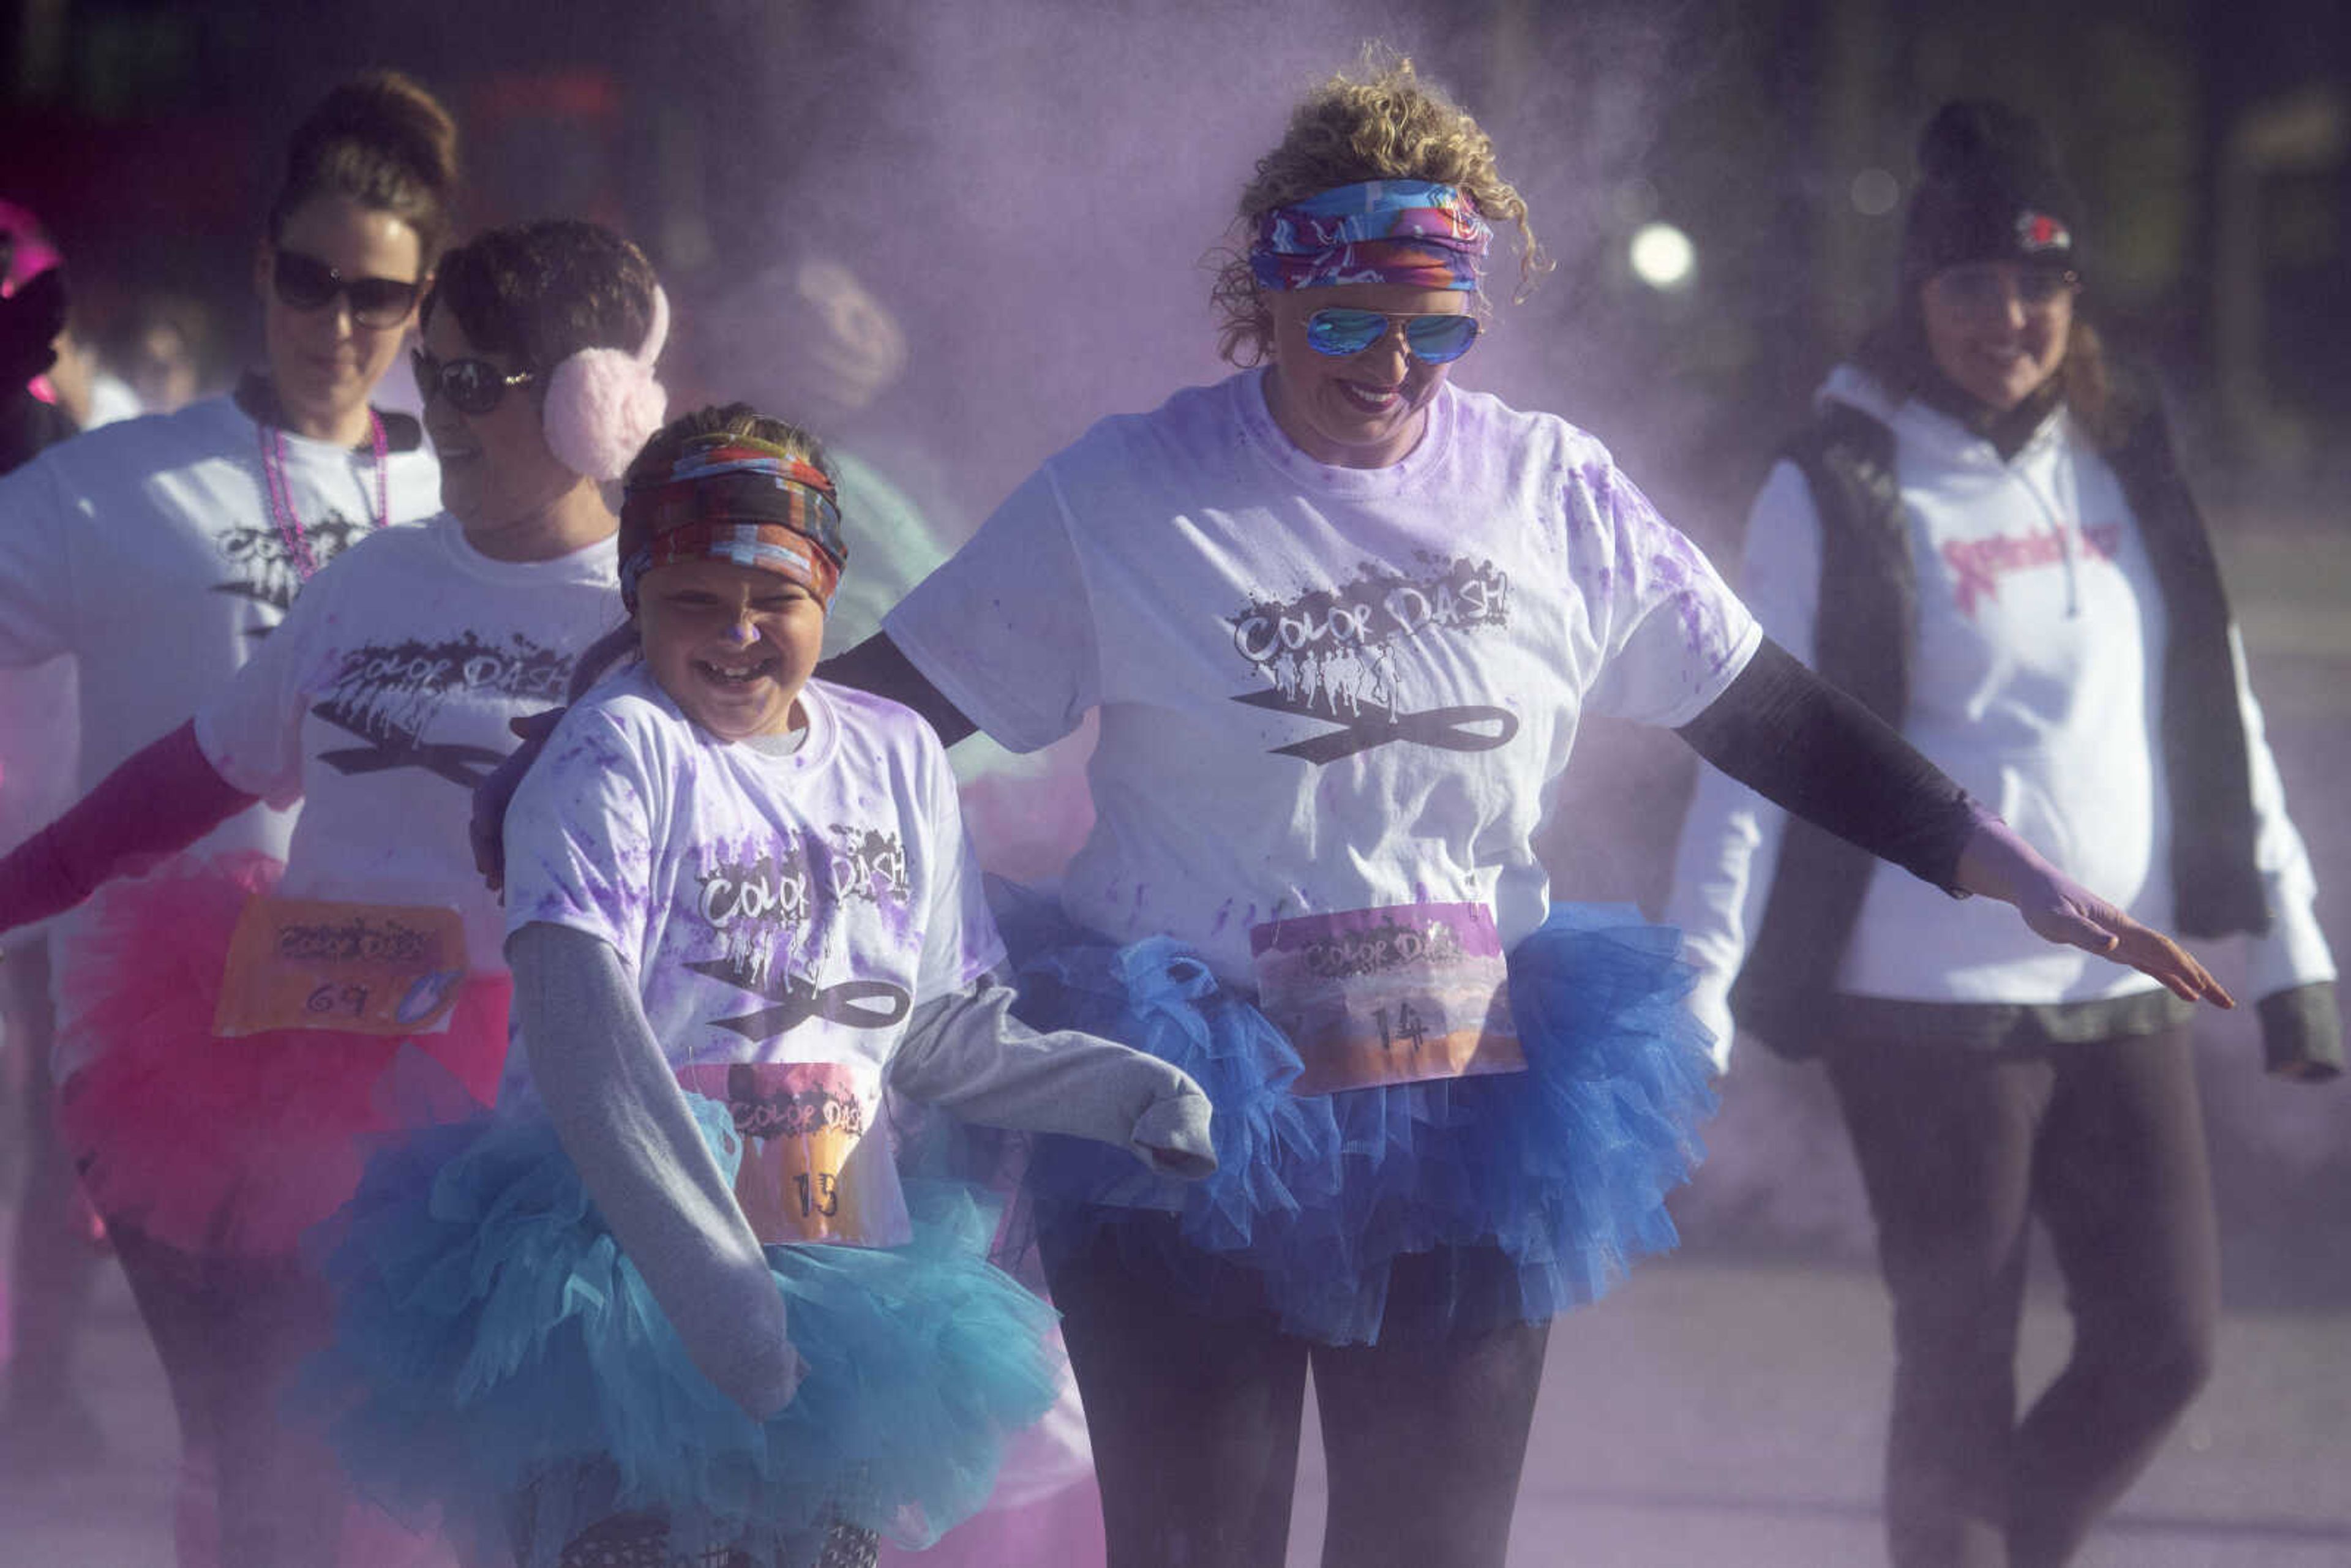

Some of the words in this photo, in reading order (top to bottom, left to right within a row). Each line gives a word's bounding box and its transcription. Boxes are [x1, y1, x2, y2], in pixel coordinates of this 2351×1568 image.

[1234, 602, 1374, 662] COLOR
[1384, 571, 1508, 636] DASH
[699, 872, 811, 929] COLOR
[831, 847, 909, 906] DASH
[1372, 1002, 1428, 1052] 14
[793, 1172, 838, 1217] 15
